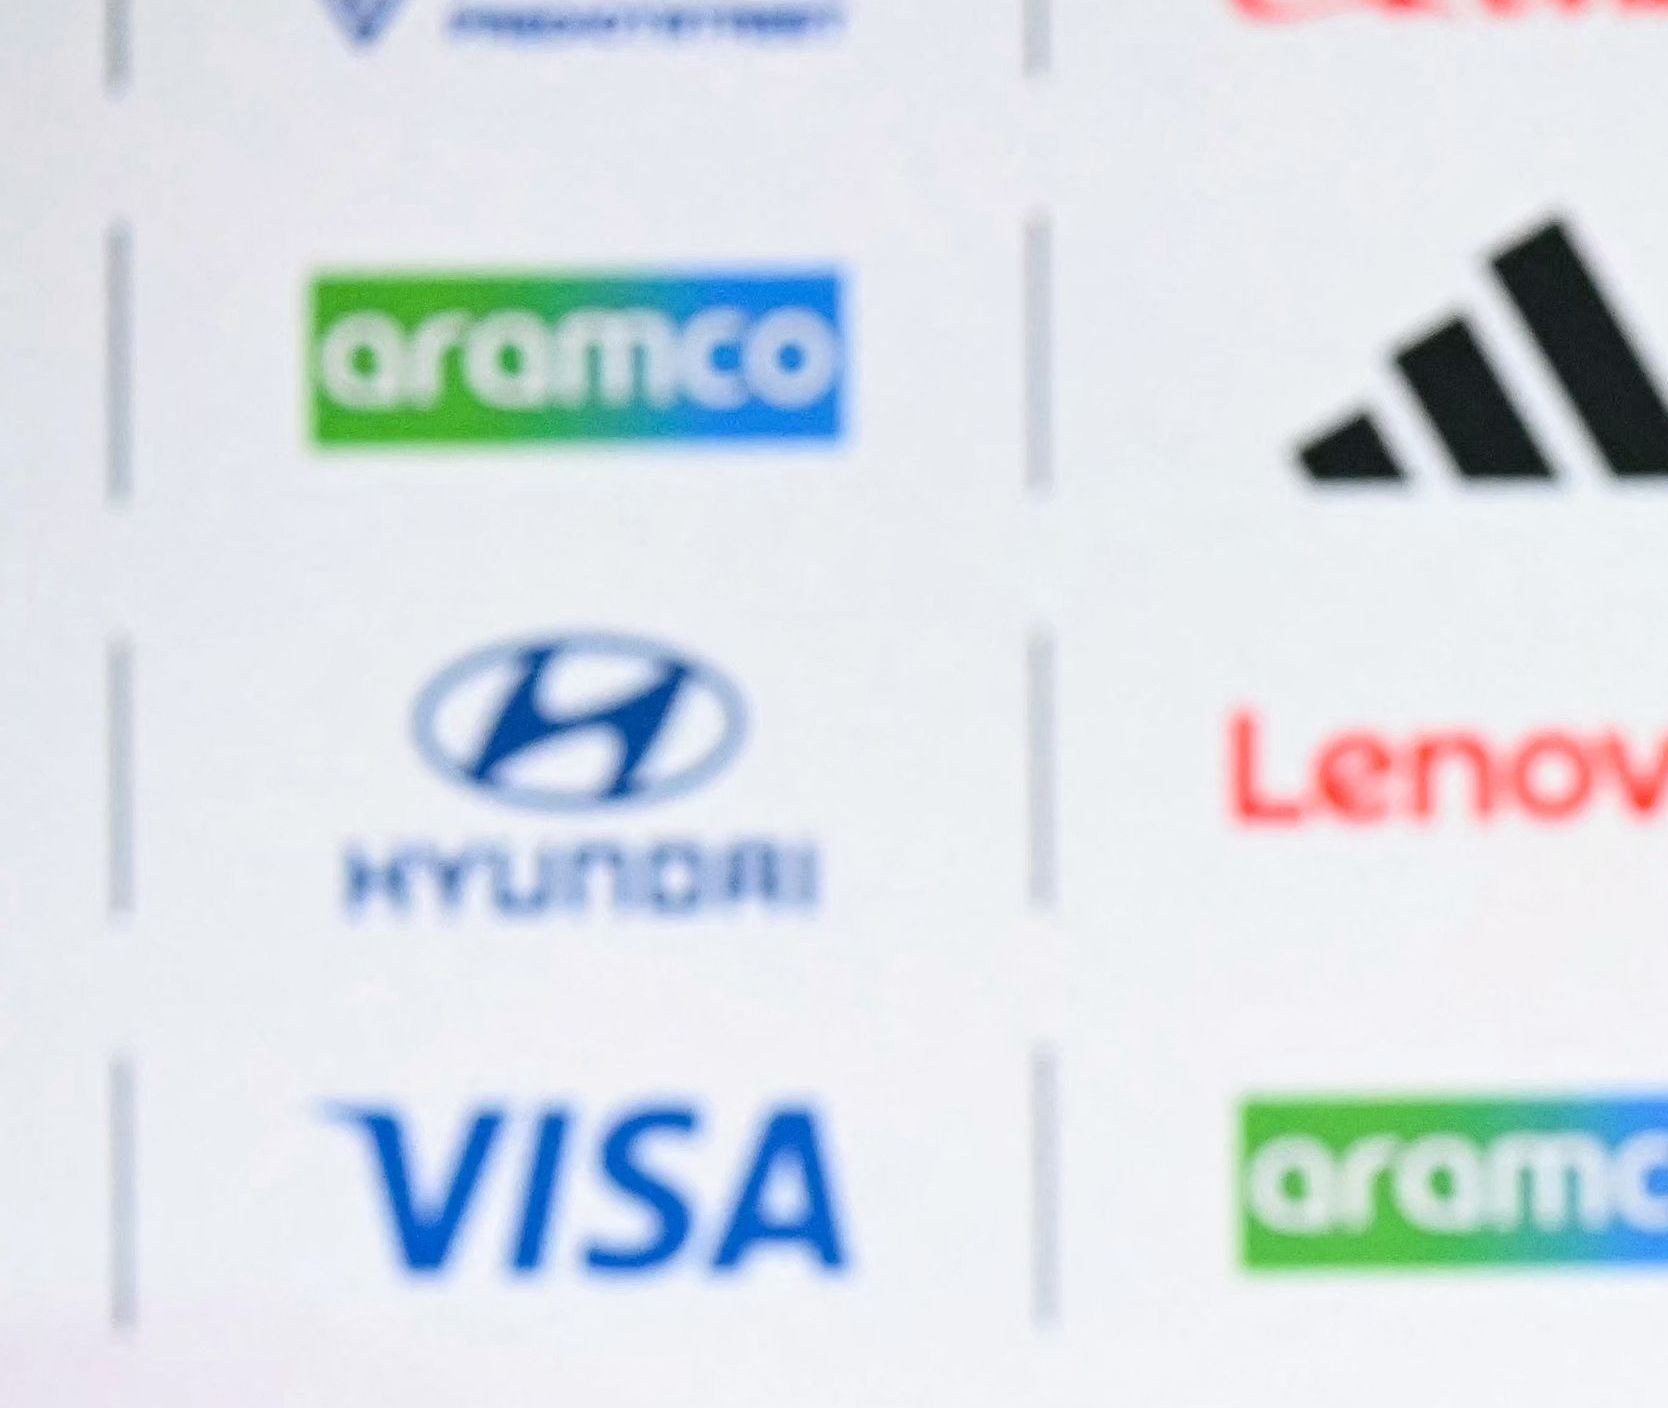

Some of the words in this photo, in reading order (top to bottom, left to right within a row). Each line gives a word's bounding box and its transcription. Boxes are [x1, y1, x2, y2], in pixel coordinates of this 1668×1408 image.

[316, 307, 840, 412] aramco
[341, 836, 820, 920] HYUNDAI
[325, 1099, 852, 1280] VISA
